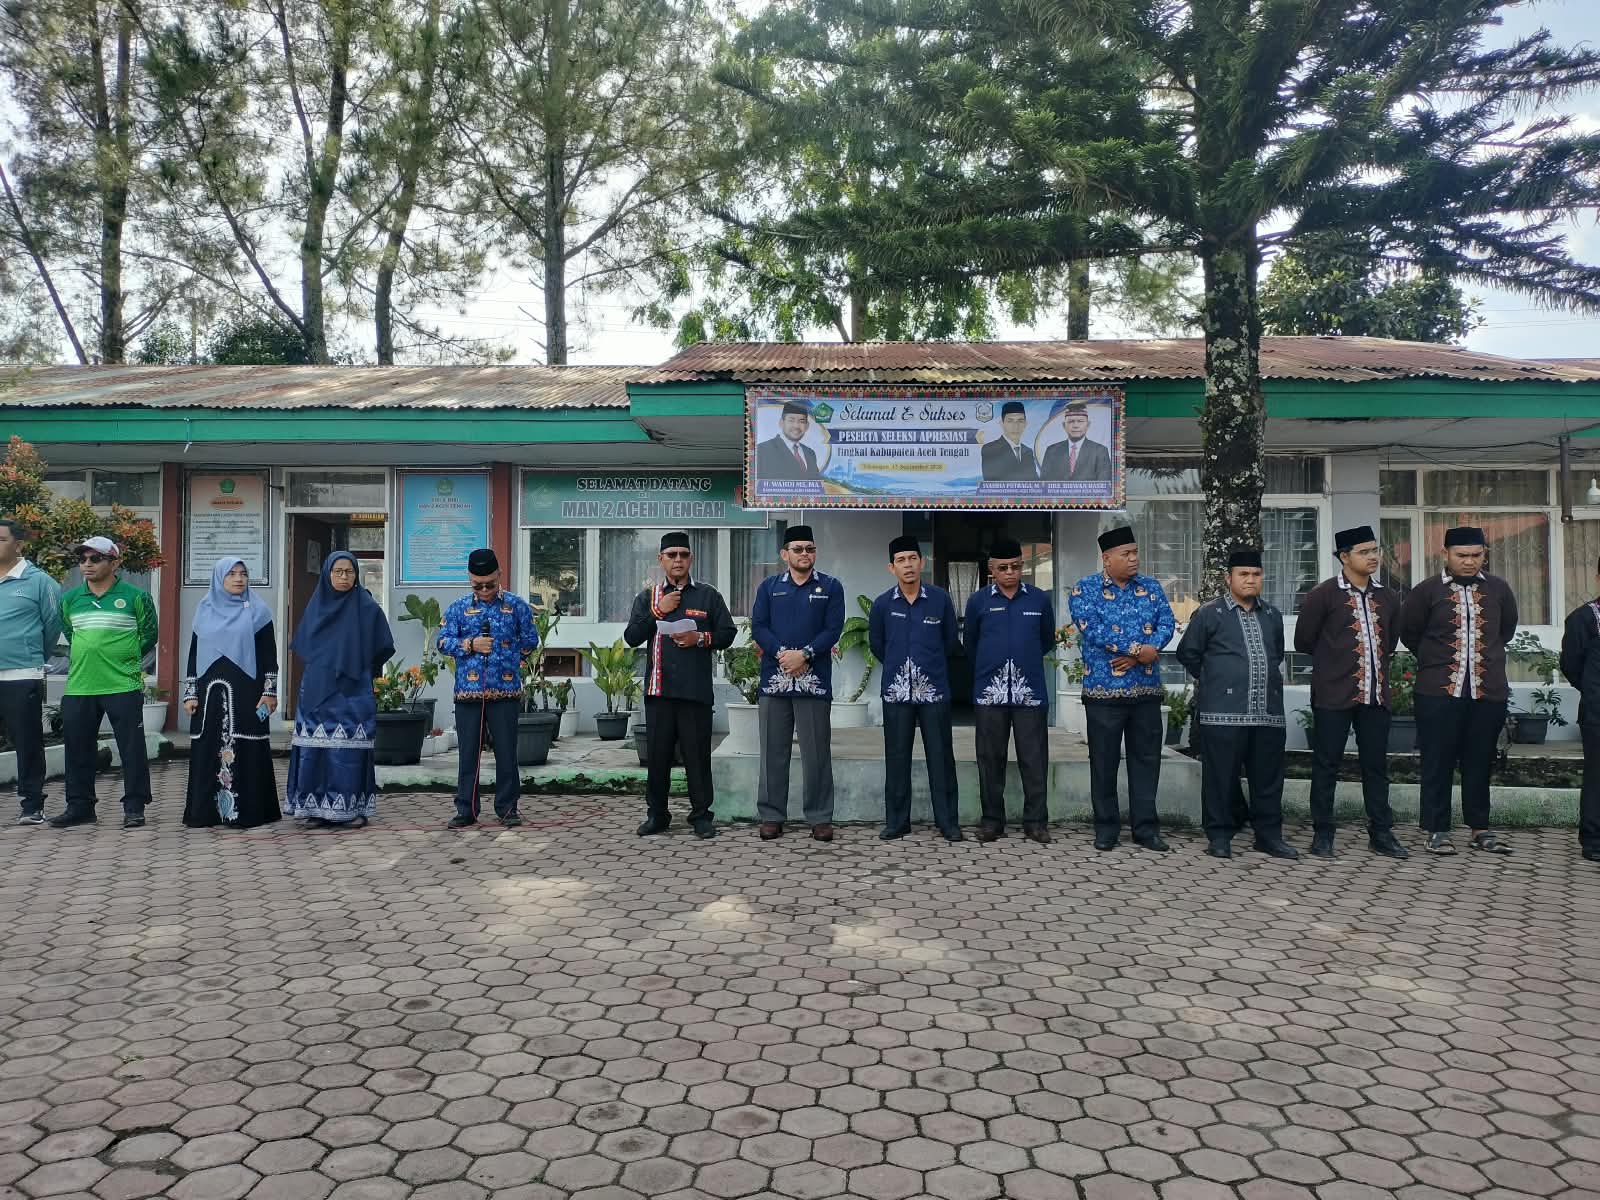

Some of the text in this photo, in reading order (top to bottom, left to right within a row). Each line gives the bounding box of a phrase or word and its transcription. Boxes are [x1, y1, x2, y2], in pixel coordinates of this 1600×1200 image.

[840, 403, 896, 421] Selamat
[920, 402, 966, 421] Sukses
[838, 431, 968, 442] PESERTA SELEKSI APRESIASI
[837, 446, 970, 459] Tingkat Kabupaten Aceh Tengah
[577, 477, 713, 492] SELAMAT DATANG
[562, 500, 726, 518] MAN 2 ACEH TENGAH
